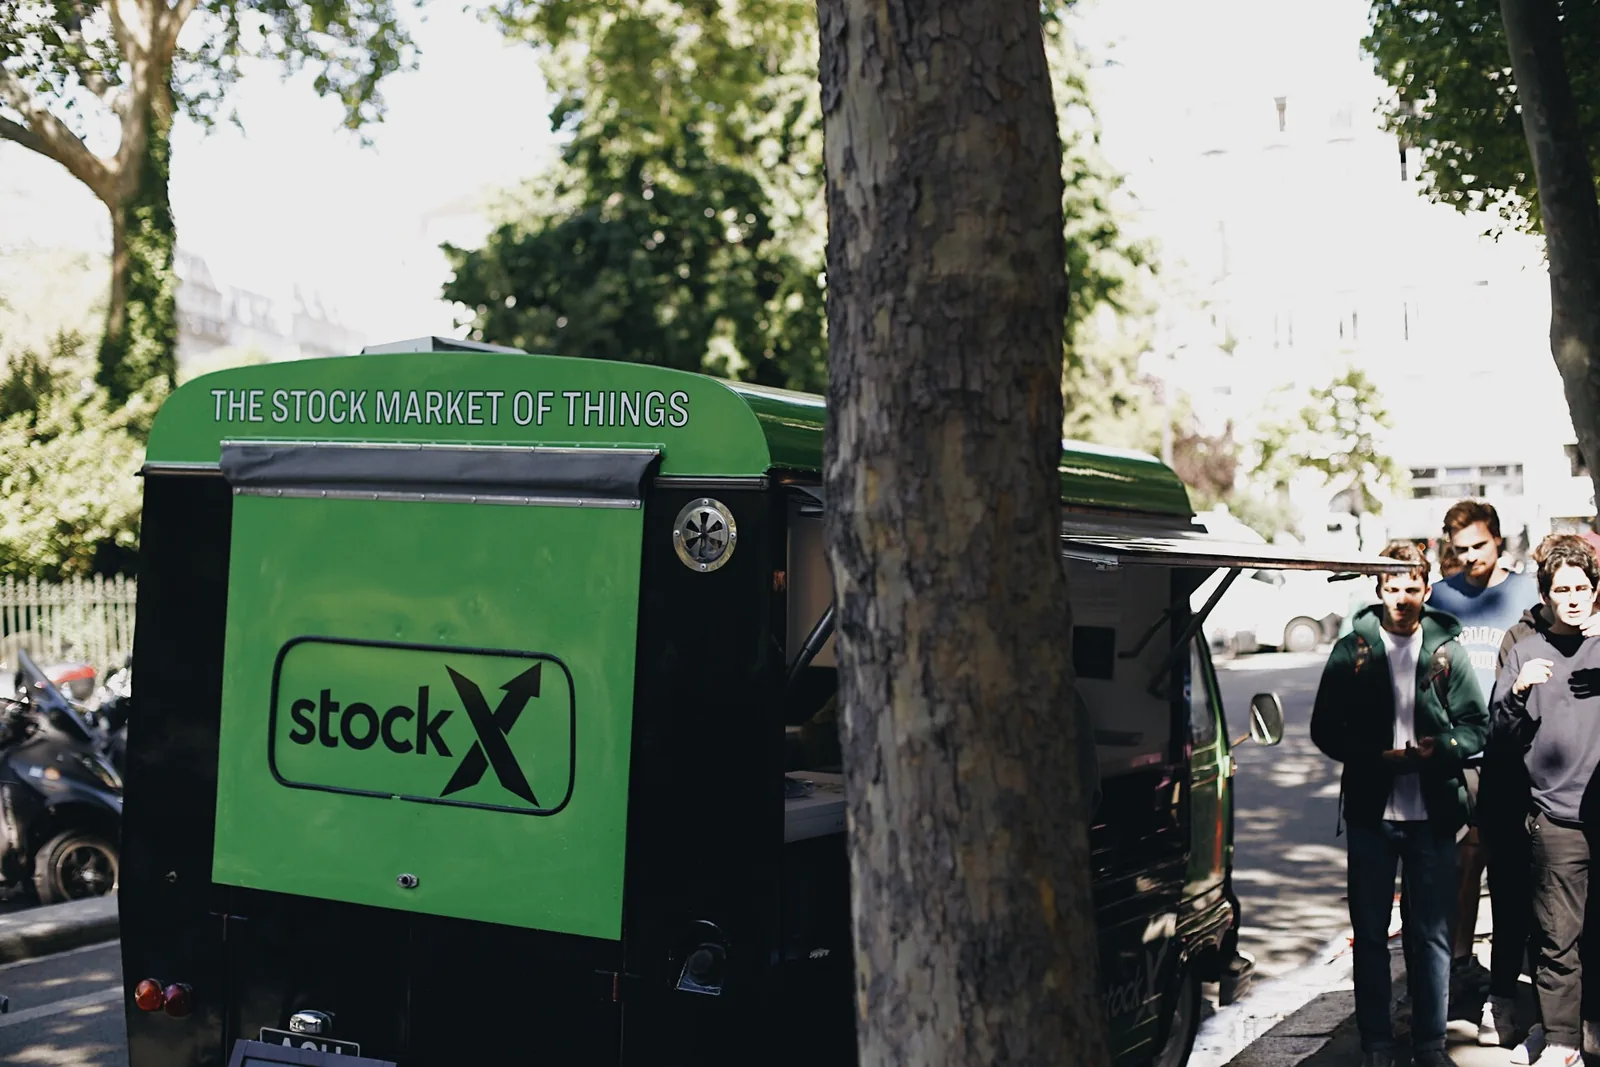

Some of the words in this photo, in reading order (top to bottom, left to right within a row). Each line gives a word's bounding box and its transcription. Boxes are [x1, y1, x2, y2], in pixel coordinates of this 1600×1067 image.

[210, 389, 265, 422] THE
[271, 389, 368, 424] STOCK
[375, 390, 505, 425] MARKET
[512, 390, 555, 427] OF
[562, 390, 690, 428] THINGS
